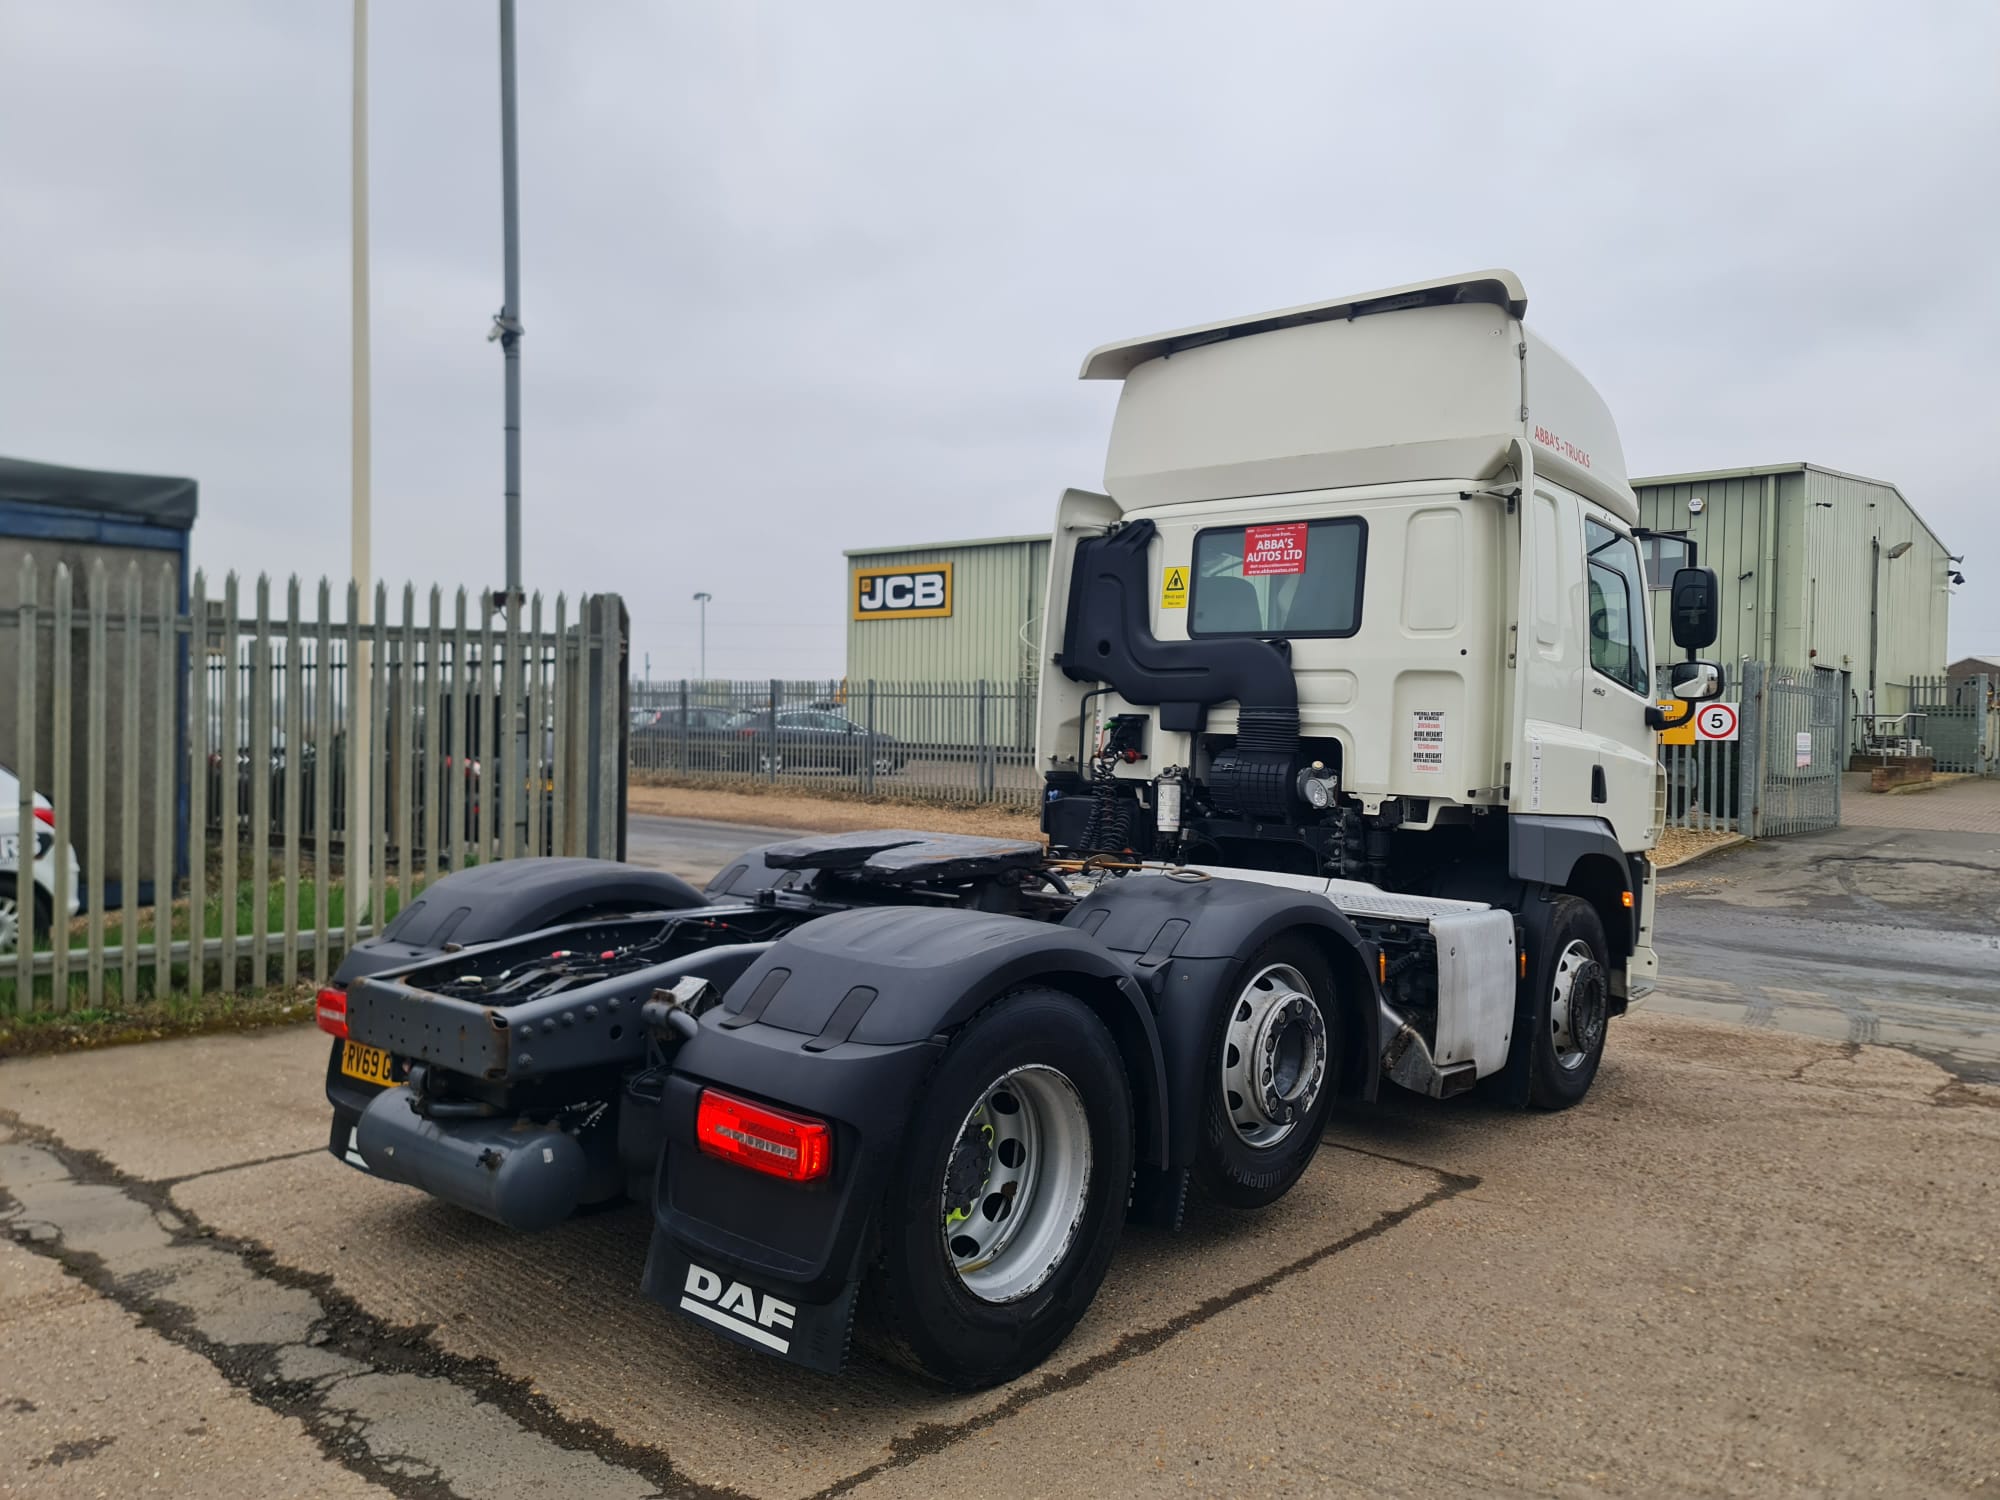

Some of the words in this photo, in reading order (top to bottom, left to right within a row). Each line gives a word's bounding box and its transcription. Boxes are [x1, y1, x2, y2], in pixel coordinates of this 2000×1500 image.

[1246, 550, 1281, 563] AUTOS
[1283, 549, 1303, 561] LTD
[1256, 538, 1294, 551] ABBA'S
[860, 574, 945, 610] JCB
[1711, 713, 1724, 729] 5
[347, 1043, 380, 1077] RV69
[684, 1263, 797, 1329] DAF
